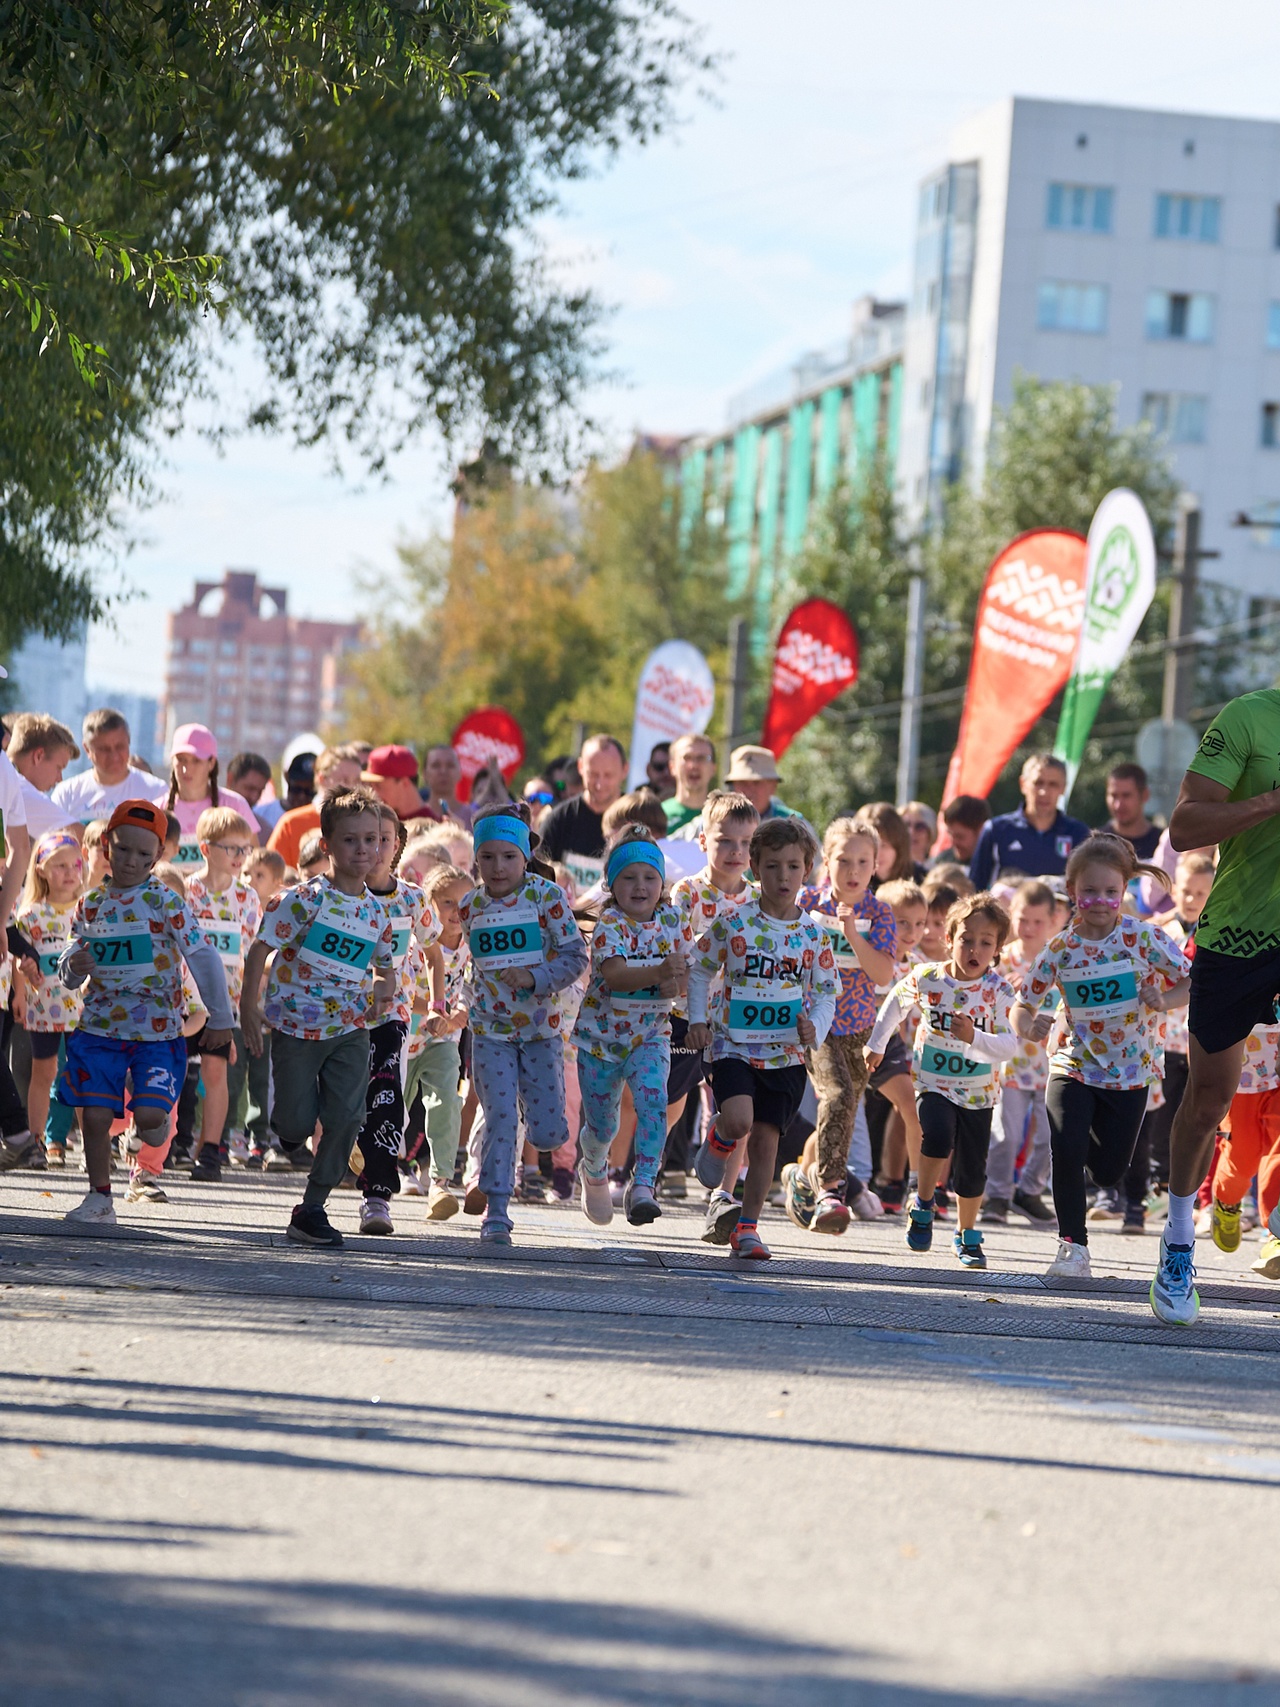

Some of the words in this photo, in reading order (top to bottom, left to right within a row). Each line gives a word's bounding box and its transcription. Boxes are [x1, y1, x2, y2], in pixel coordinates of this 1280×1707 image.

[178, 847, 204, 861] 93
[93, 939, 134, 962] 971
[321, 932, 365, 963] 857
[478, 928, 527, 953] 880
[1076, 979, 1123, 1005] 952
[743, 1005, 791, 1027] 908
[933, 1052, 980, 1074] 909
